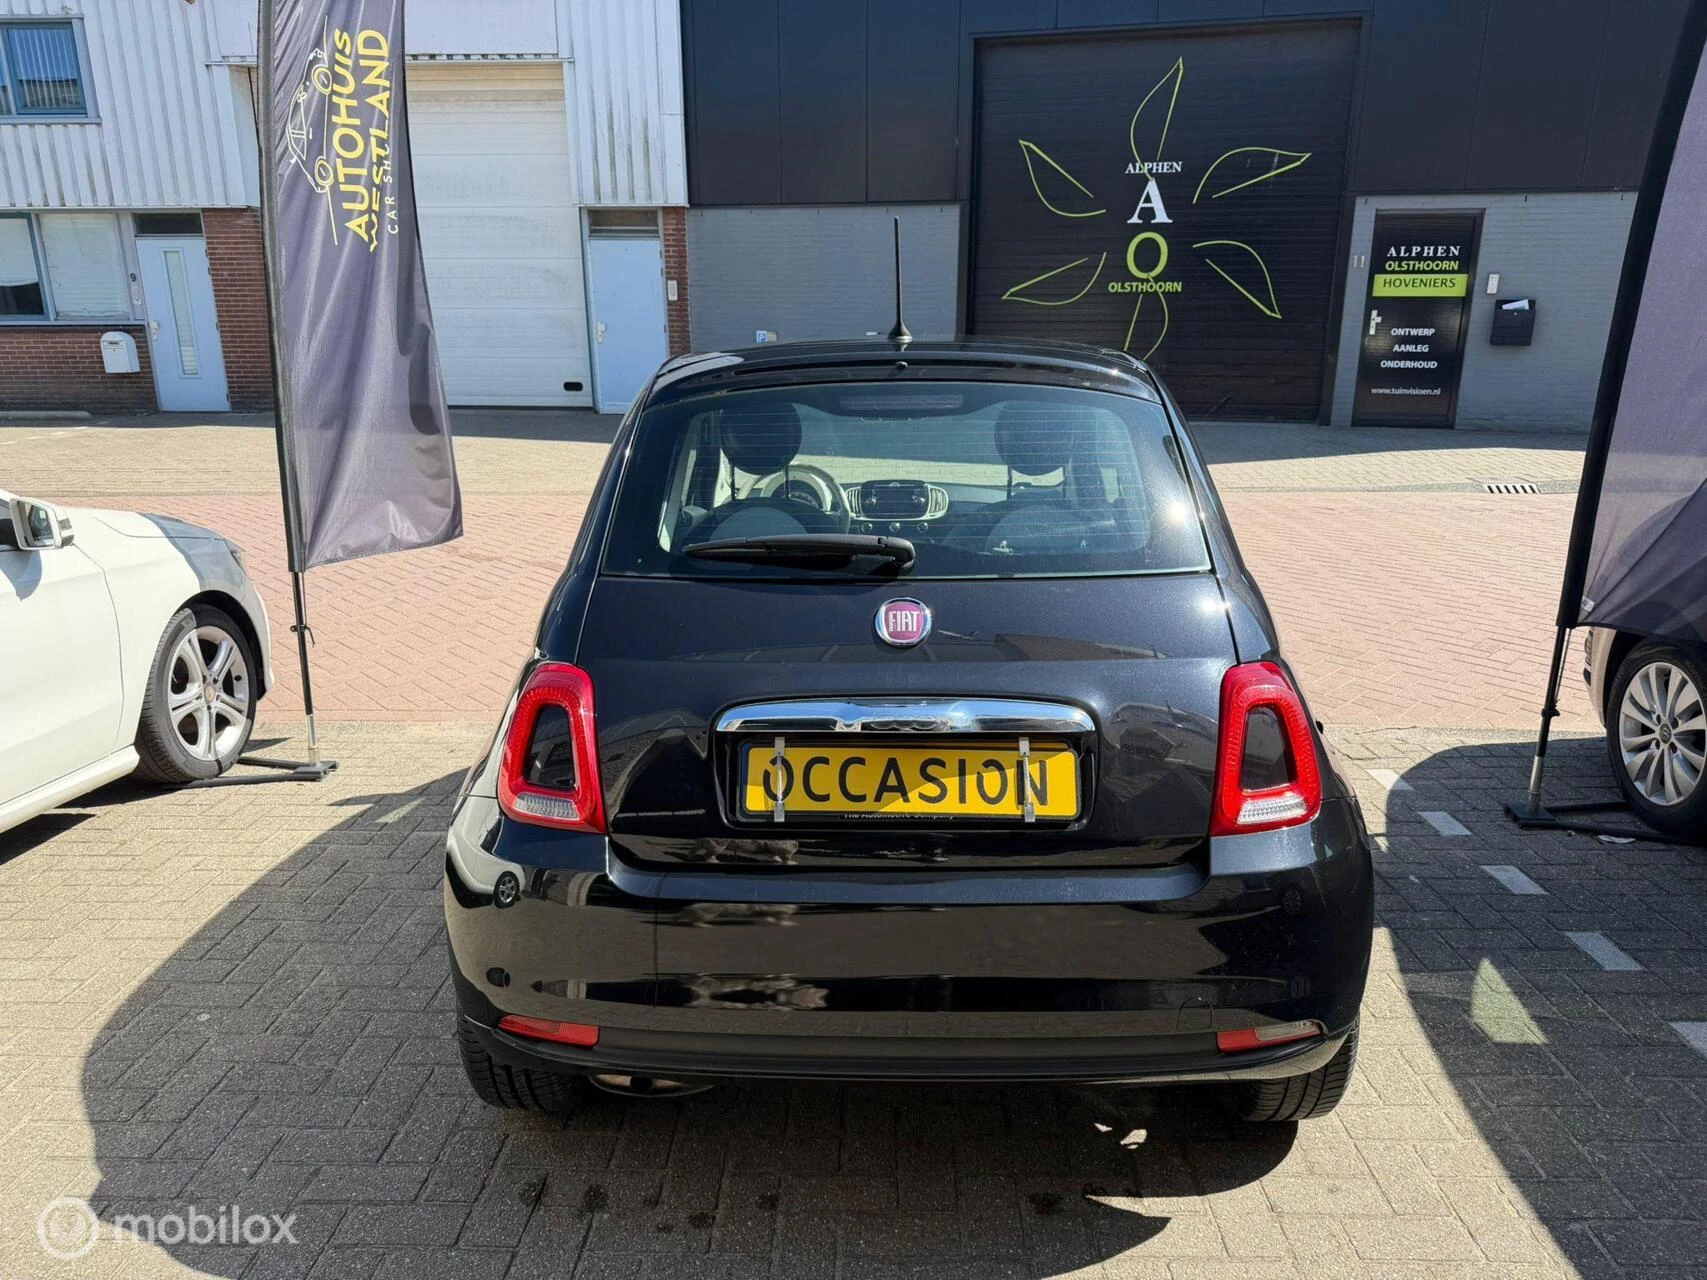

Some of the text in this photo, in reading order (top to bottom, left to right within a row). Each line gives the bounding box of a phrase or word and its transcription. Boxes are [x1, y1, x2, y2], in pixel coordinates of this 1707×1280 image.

[331, 28, 370, 243] AUTOHUIS
[1125, 161, 1183, 174] ALPHEN
[1126, 177, 1174, 224] A
[385, 196, 399, 235] CAR
[1126, 231, 1169, 279] O
[1386, 245, 1461, 258] ALPHEN
[1385, 260, 1459, 272] OLSTHOORN
[1108, 281, 1183, 293] OLSTHOORN
[1382, 277, 1456, 289] HOVENIERS
[1390, 327, 1436, 337] ONTWERP
[1392, 343, 1430, 353] AANLEG
[1380, 359, 1438, 369] ONDERHOUD
[1370, 387, 1442, 396] www.tuinvisioen.nl
[888, 610, 919, 632] FIAT
[762, 756, 1048, 806] OCCASION
